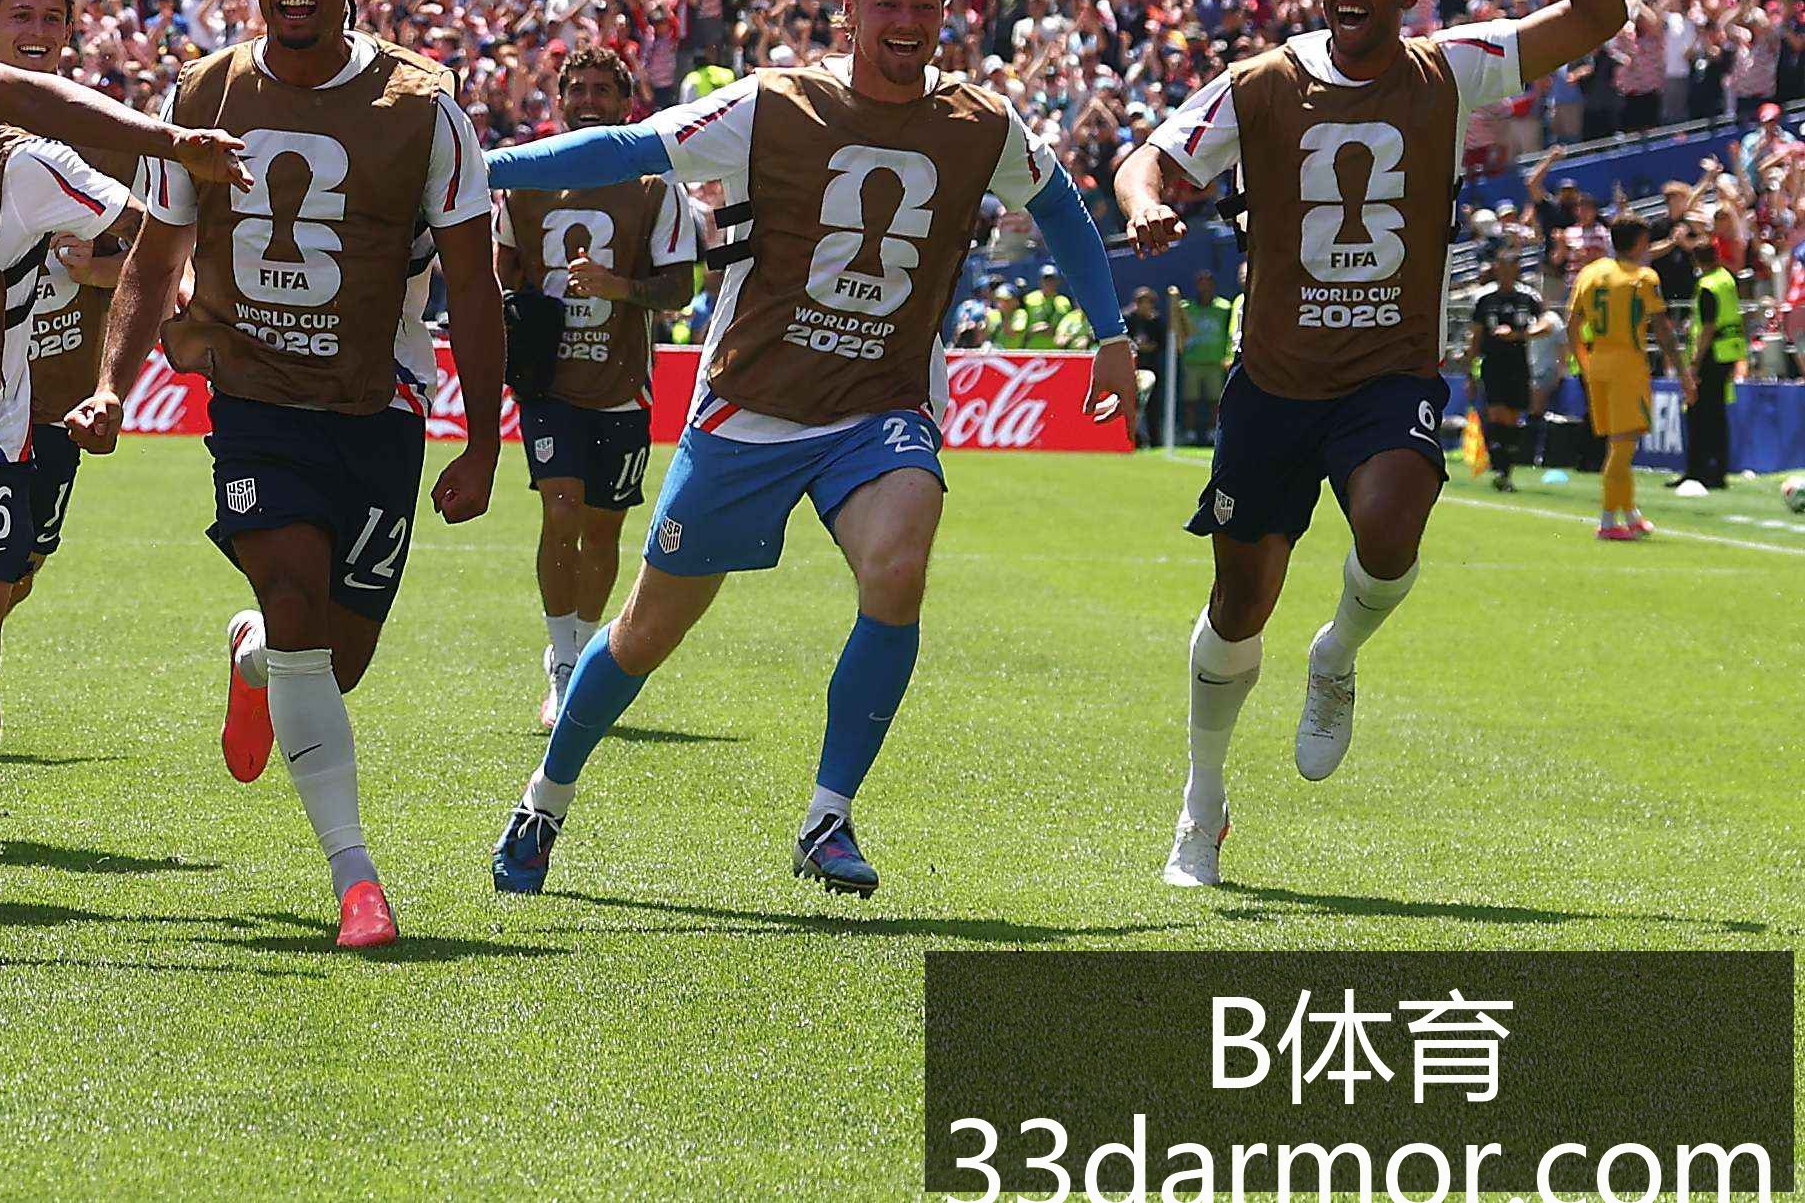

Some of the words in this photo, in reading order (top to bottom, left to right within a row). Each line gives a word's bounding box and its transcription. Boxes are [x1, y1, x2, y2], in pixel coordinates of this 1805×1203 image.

[1330, 252, 1378, 269] FIFA
[259, 269, 310, 291] FIFA
[834, 277, 882, 302] FIFA
[1301, 286, 1365, 302] WORLD
[1368, 286, 1402, 302] CUP
[53, 311, 82, 331] CUP
[236, 302, 297, 328] WORLD
[300, 314, 340, 330] CUP
[795, 306, 859, 332] WORLD
[861, 320, 895, 338] CUP
[1299, 304, 1401, 329] 2026
[1593, 287, 1609, 336] 5
[27, 328, 83, 362] 026
[584, 331, 611, 342] CUP
[783, 323, 885, 360] 2026
[557, 343, 609, 362] 026
[1418, 399, 1435, 432] 6
[615, 447, 646, 490] 10
[228, 480, 254, 494] USA
[345, 506, 407, 579] 12
